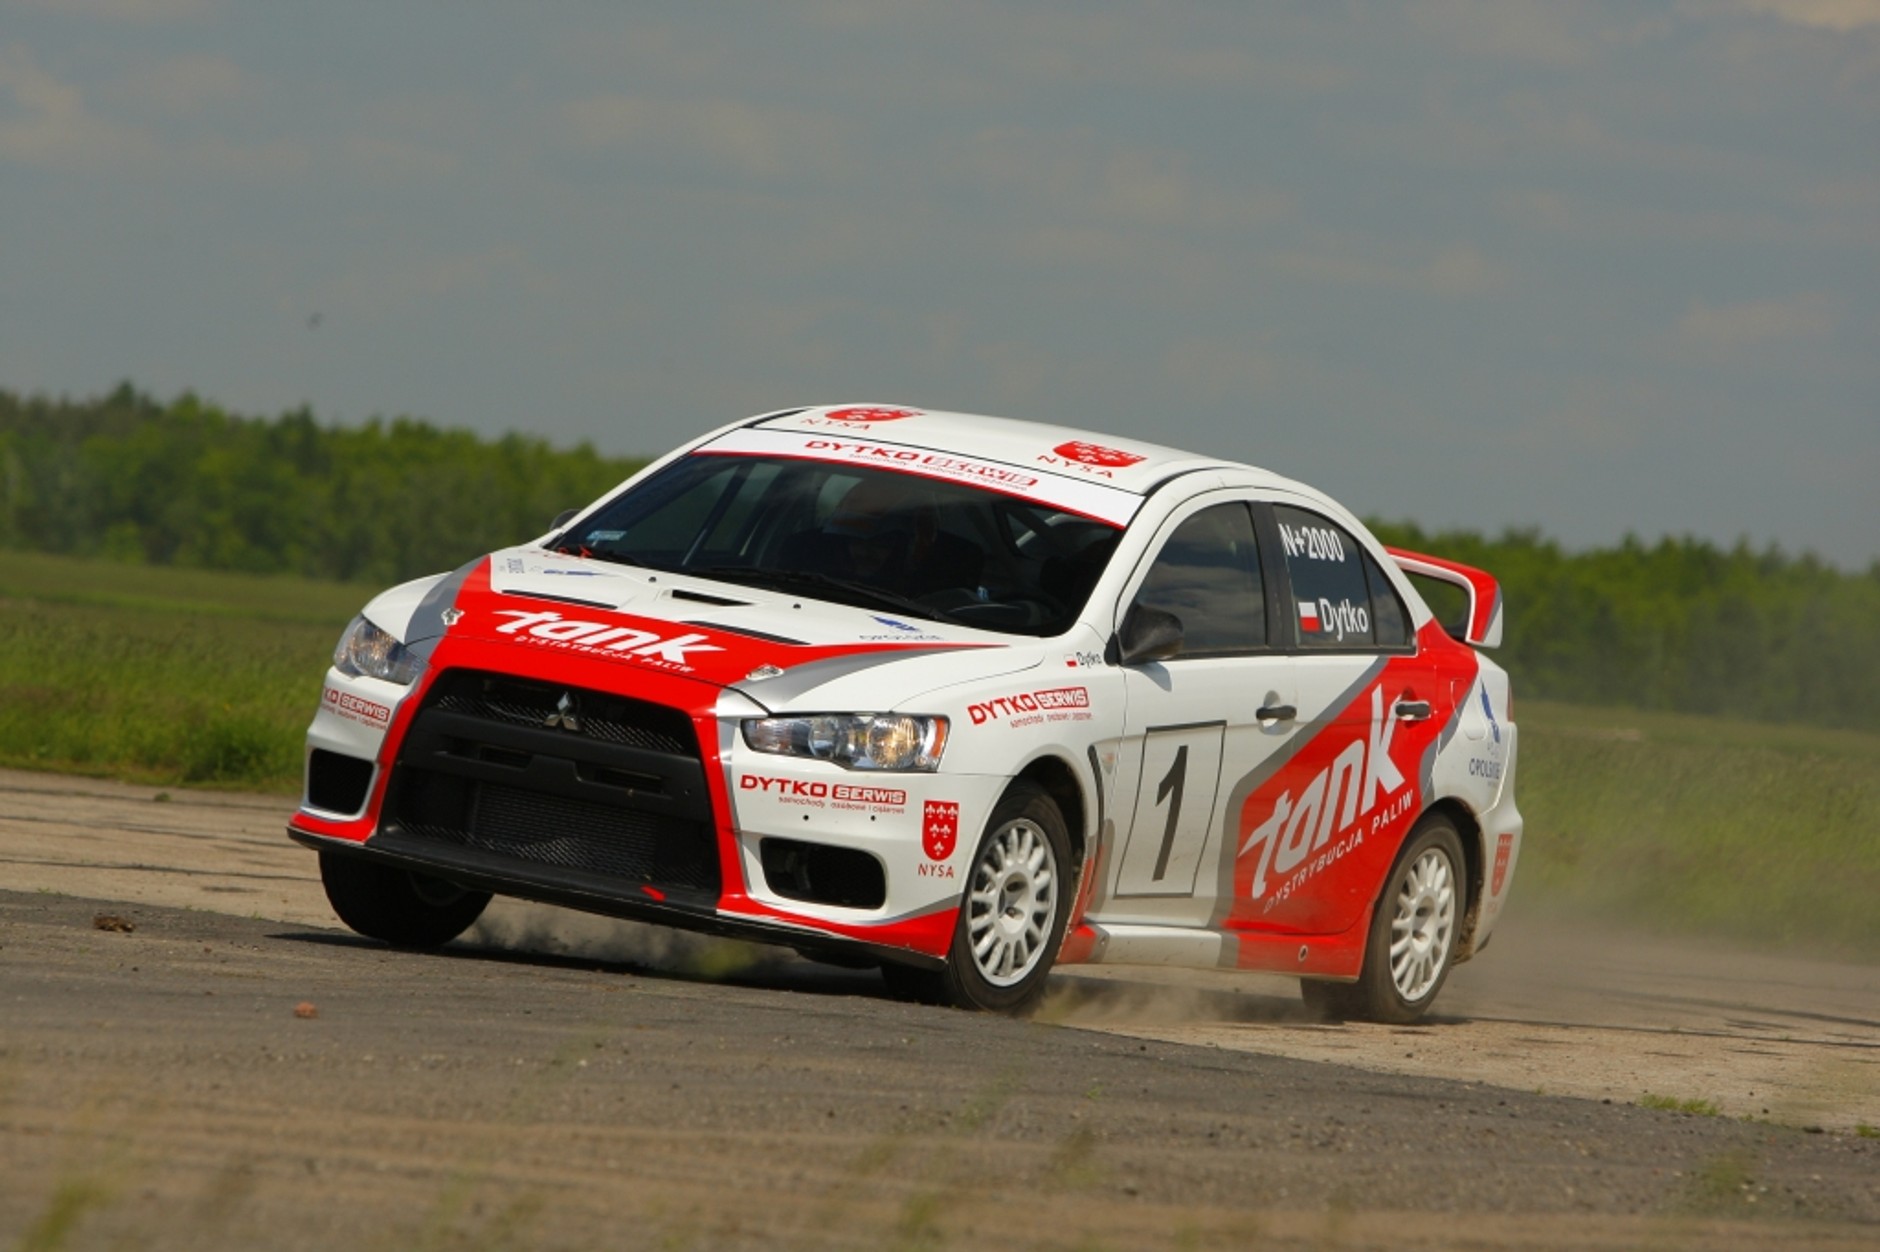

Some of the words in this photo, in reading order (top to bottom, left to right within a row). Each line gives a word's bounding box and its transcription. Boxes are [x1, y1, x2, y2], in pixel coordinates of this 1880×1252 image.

[801, 417, 871, 431] NYSA
[805, 440, 920, 461] DYTKO
[1036, 454, 1113, 479] NYSA
[1278, 523, 1345, 562] N+2000
[492, 609, 728, 664] tank
[1318, 598, 1368, 642] Dytko
[514, 635, 633, 661] DYSTRYBUCJA
[641, 656, 696, 674] PALIW
[340, 692, 391, 723] SERWIS
[967, 693, 1039, 726] DYTKO
[1034, 687, 1090, 709] SERWIS
[740, 774, 828, 799] DYTKO
[832, 784, 907, 806] SERWIS
[1238, 683, 1406, 900] tank
[1152, 744, 1189, 882] 1
[917, 862, 955, 879] NYSA
[1263, 827, 1364, 915] DYSTRYBUCJA
[1371, 788, 1414, 836] PALIW
